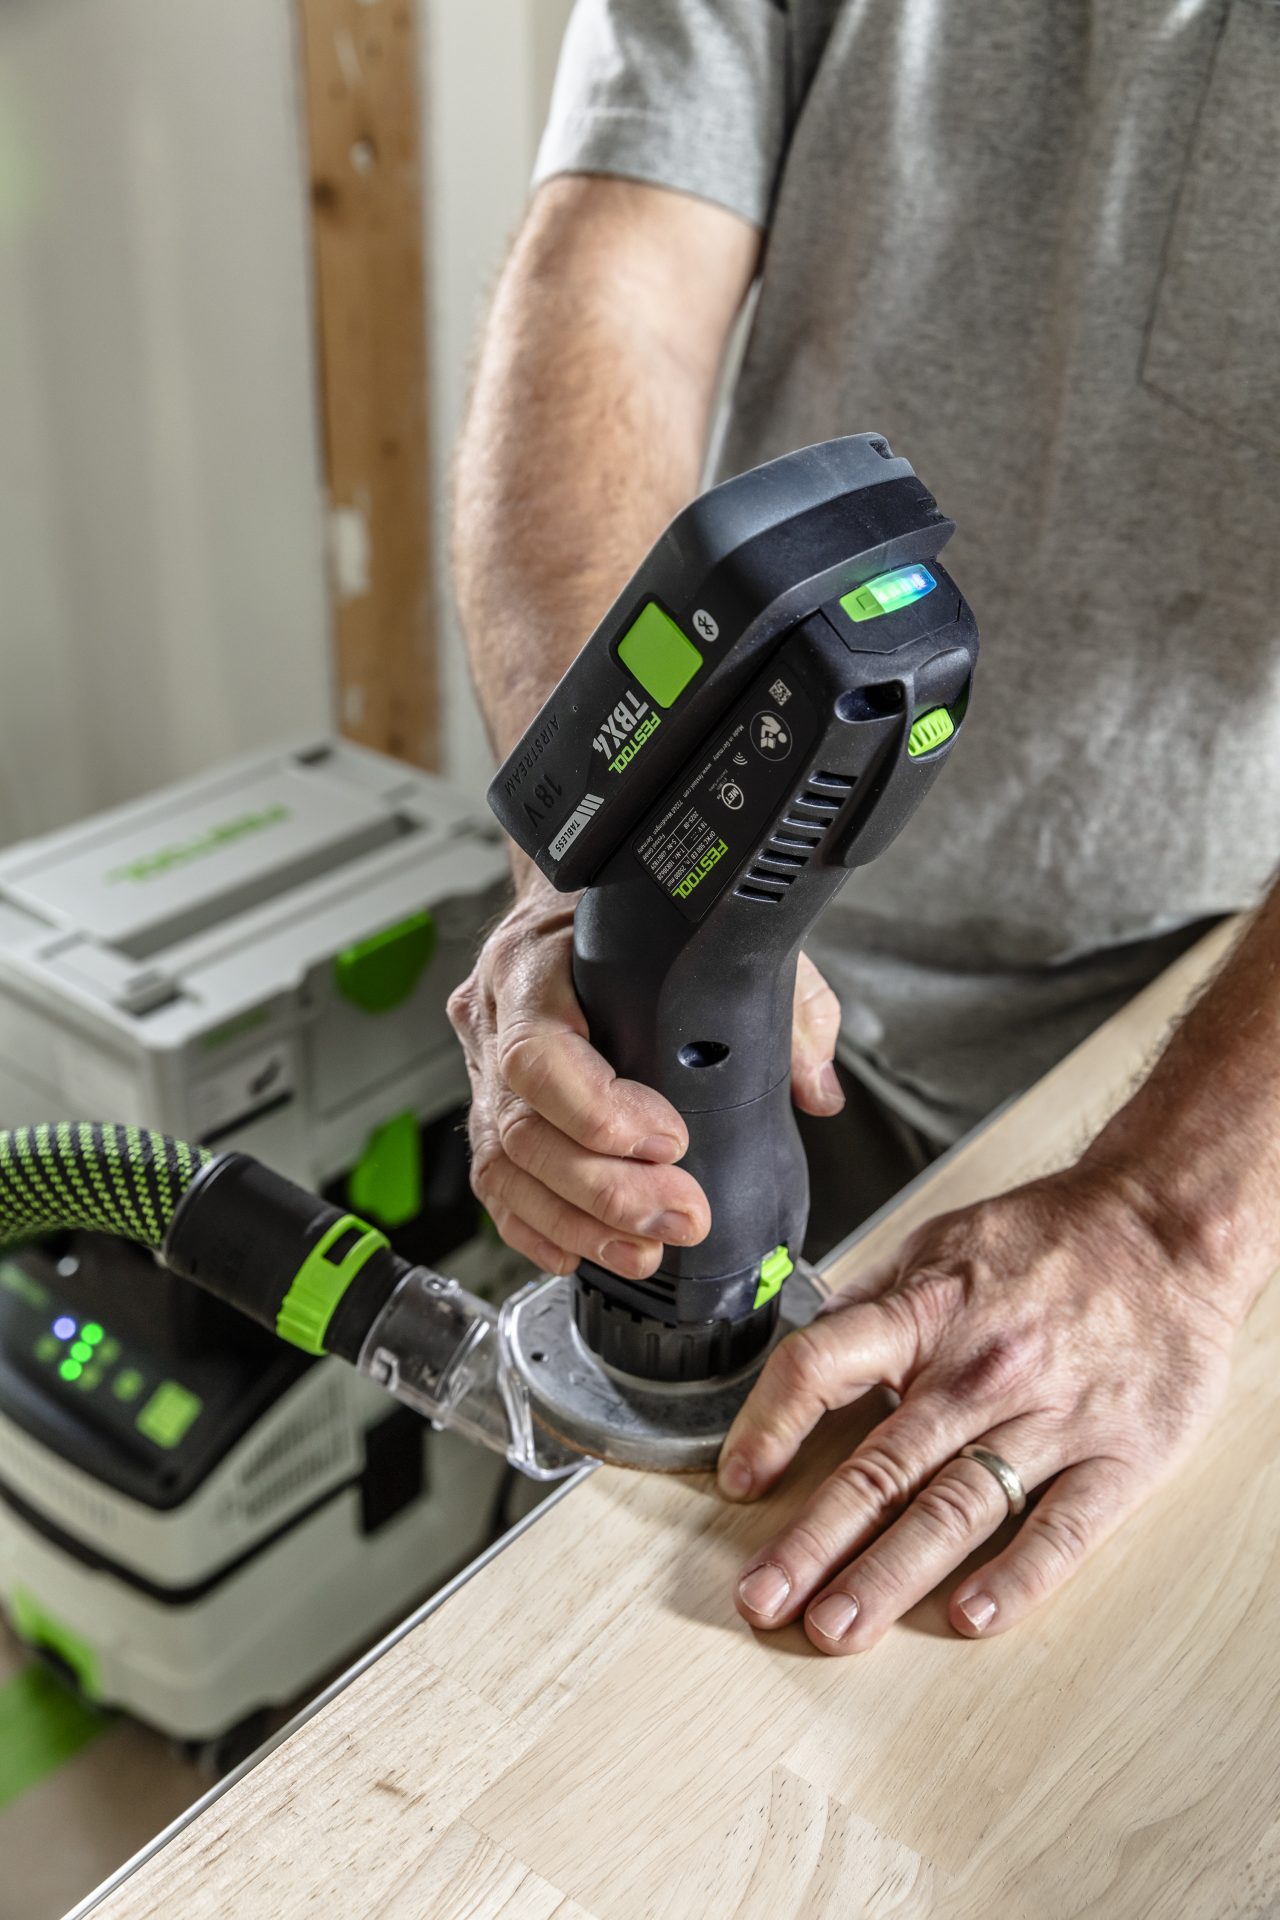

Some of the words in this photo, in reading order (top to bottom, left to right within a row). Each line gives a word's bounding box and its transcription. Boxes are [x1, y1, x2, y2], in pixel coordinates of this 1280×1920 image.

[587, 689, 649, 760] TBX4
[731, 723, 744, 738] Made
[606, 709, 662, 775] FESTOOL
[712, 740, 731, 761] Germany
[727, 735, 734, 743] in
[501, 713, 560, 798] AIRSTREAM
[530, 772, 565, 810] 18
[681, 762, 712, 798] www.festool.com
[723, 786, 740, 805] MET
[525, 803, 546, 828] V
[699, 820, 707, 828] 18
[553, 818, 580, 852] TABLESS
[636, 835, 653, 855] Germany
[650, 832, 665, 849] Festool
[702, 829, 716, 845] OFKC
[671, 837, 729, 900] FESTOOL
